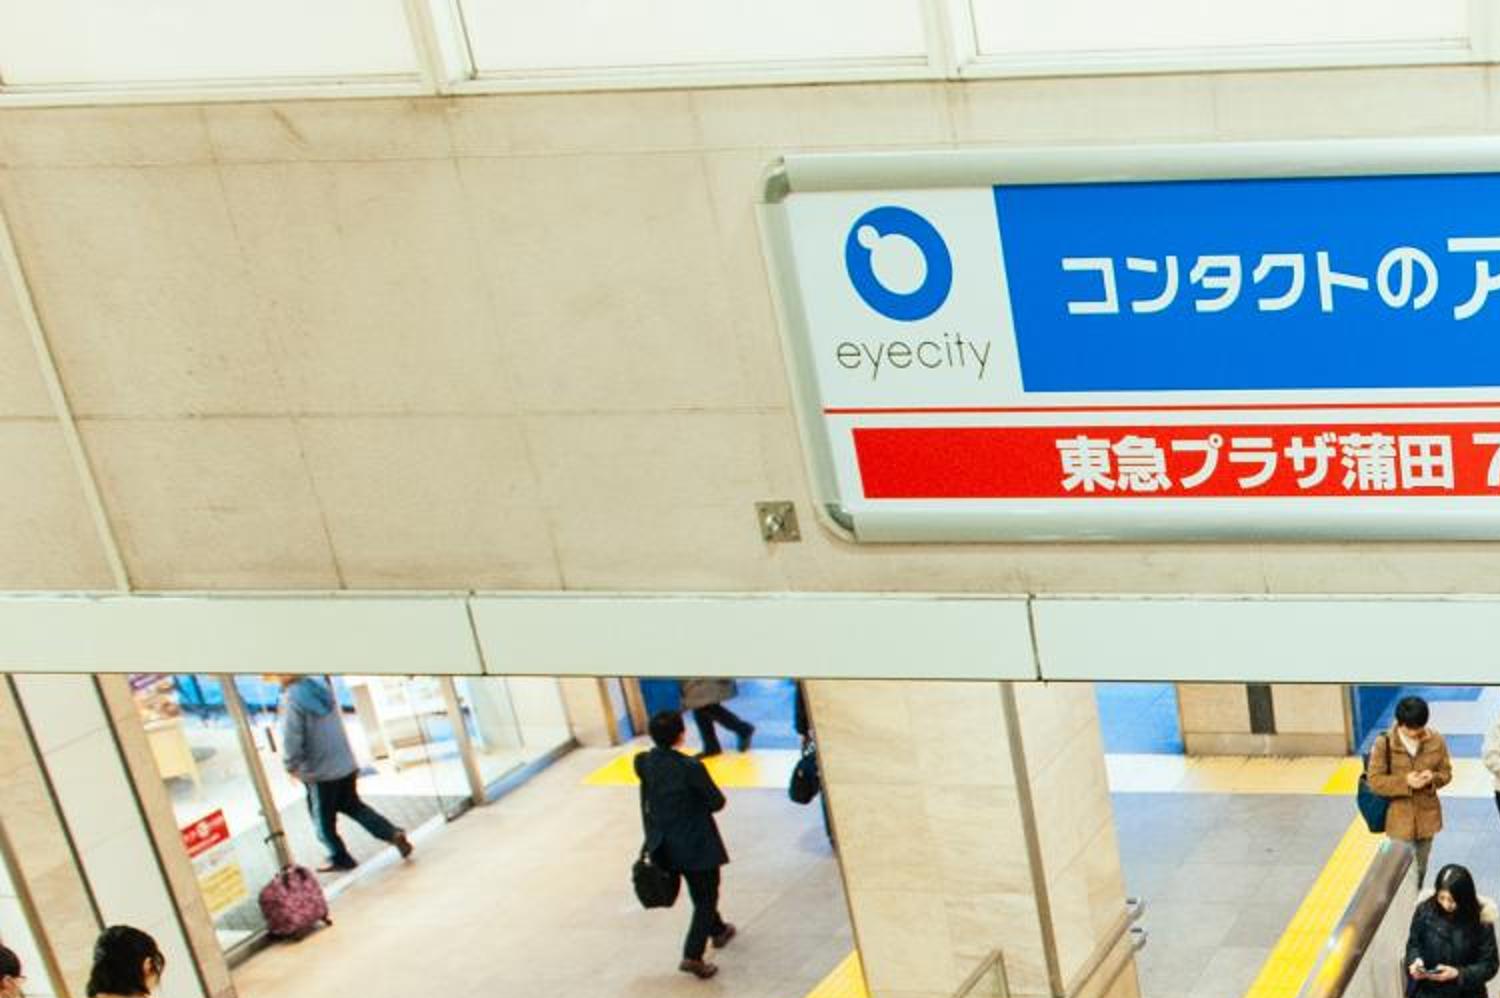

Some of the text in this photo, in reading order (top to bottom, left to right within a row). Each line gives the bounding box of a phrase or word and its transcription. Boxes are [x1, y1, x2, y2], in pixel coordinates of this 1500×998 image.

[837, 332, 991, 380] eyecity
[1055, 432, 1454, 491] 東急プラザ蒲田
